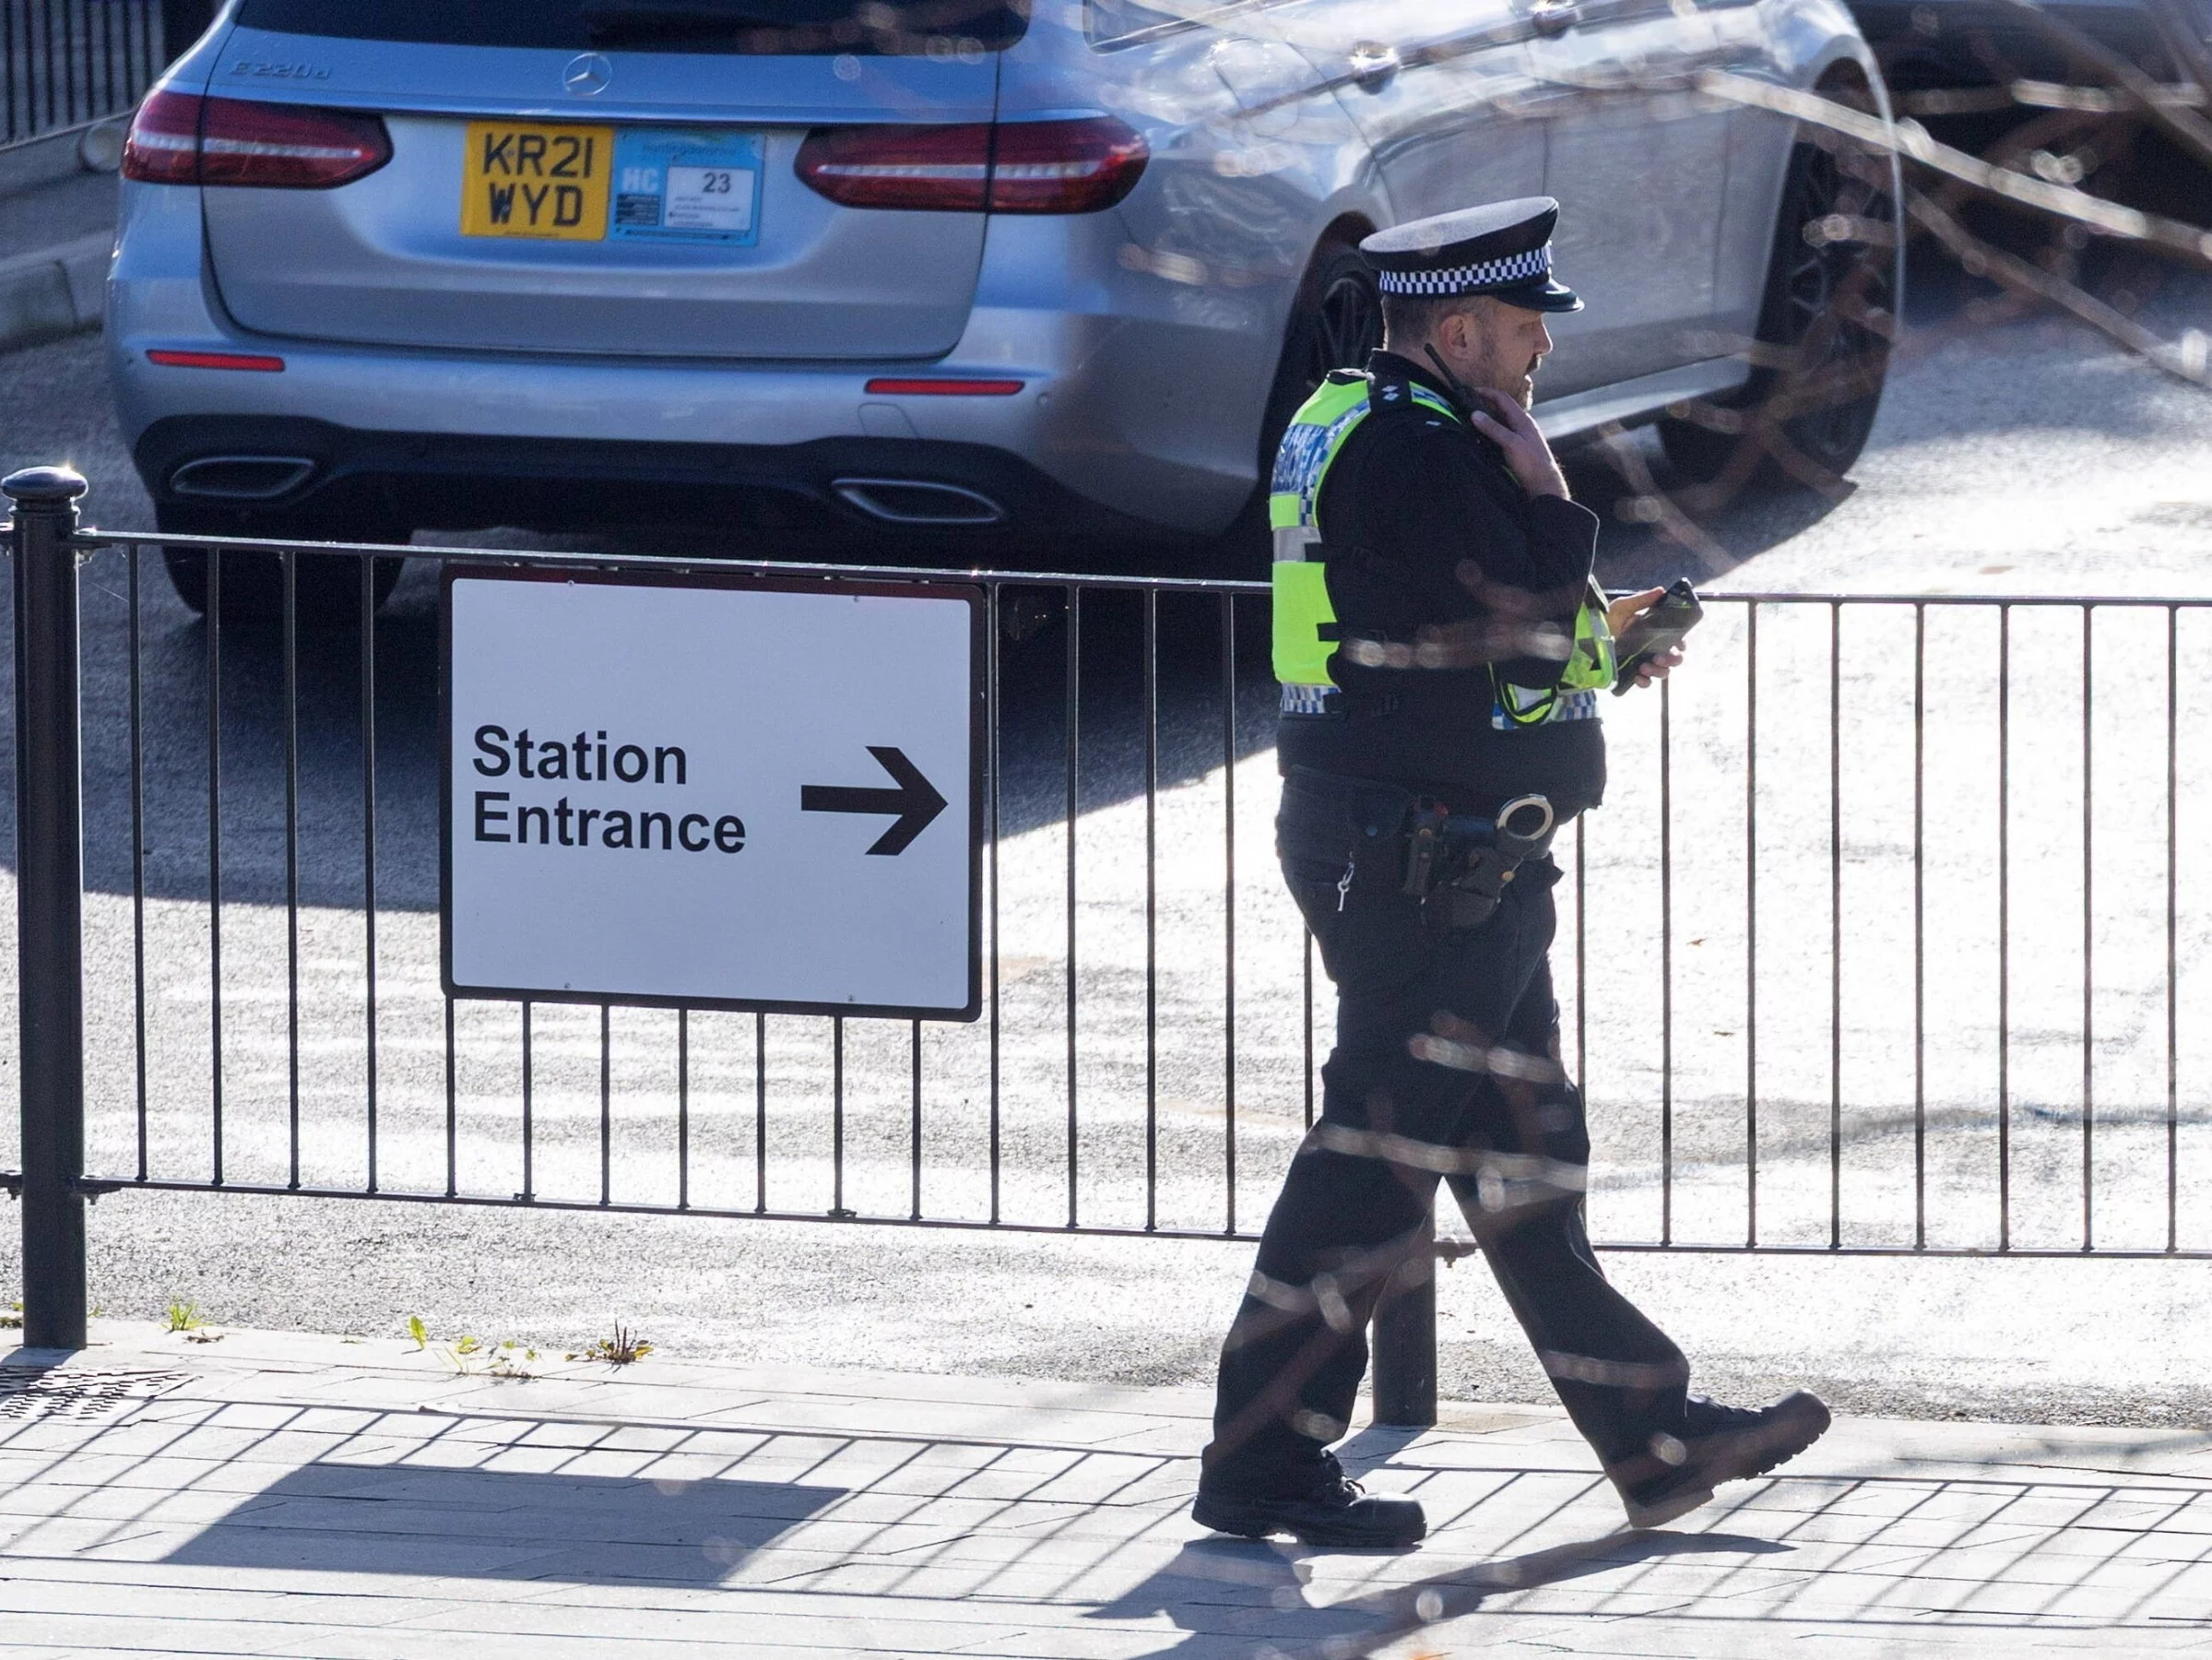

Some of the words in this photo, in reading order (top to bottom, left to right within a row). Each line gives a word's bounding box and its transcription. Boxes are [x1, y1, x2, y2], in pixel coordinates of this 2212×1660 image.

[483, 132, 593, 178] KR21
[489, 183, 583, 227] WYD
[703, 172, 732, 195] 23
[473, 724, 688, 785] Station
[474, 790, 747, 855] Entrance
